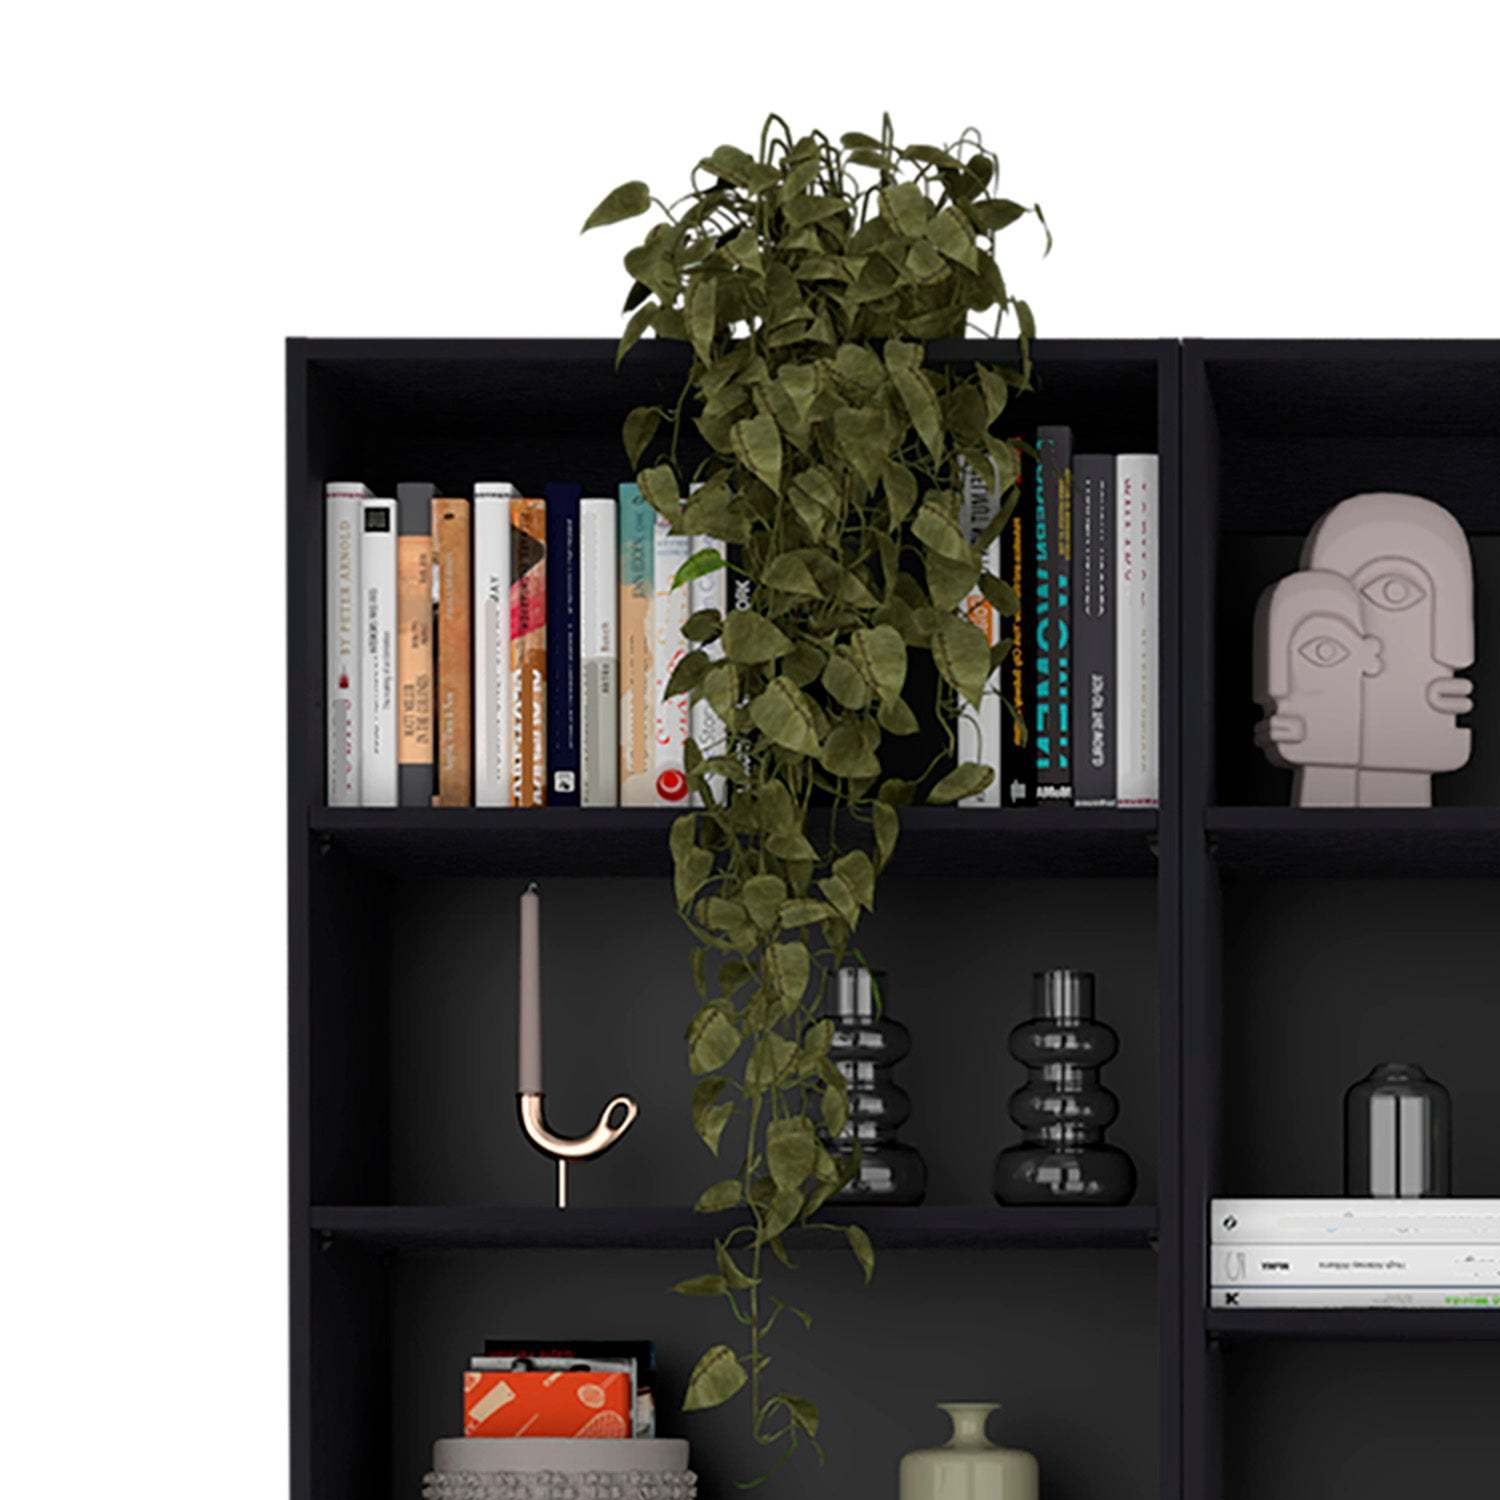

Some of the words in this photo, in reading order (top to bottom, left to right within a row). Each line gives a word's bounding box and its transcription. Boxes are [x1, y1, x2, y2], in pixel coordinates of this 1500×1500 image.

[339, 519, 351, 581] ARNOLD
[339, 588, 351, 633] PETER
[339, 639, 351, 656] BY
